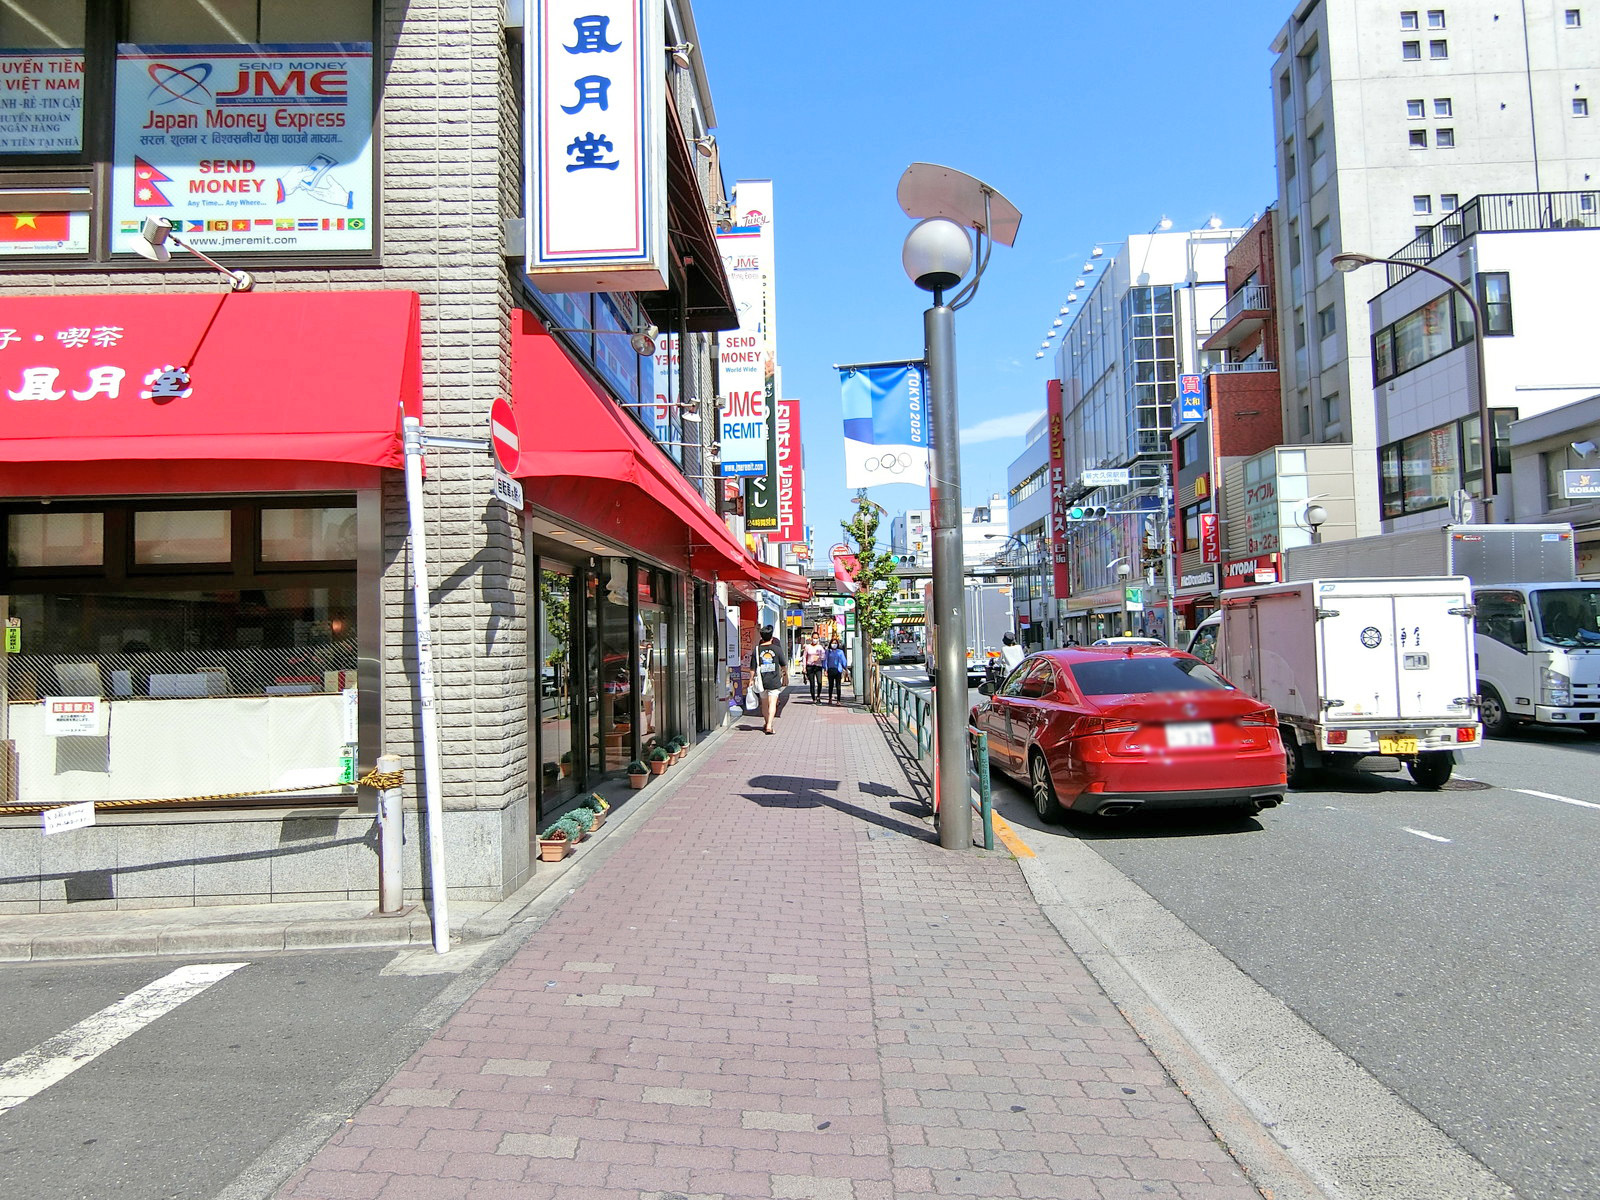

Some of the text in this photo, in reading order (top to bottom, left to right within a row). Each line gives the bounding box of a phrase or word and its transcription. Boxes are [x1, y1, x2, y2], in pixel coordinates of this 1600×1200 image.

[239, 62, 347, 71] SEND MONEY
[5, 76, 80, 94] VIỆT NAM
[216, 71, 348, 96] JME
[143, 109, 346, 133] Japan Money Express
[199, 160, 256, 174] SEND
[189, 179, 266, 193] MONEY
[225, 200, 238, 208] Any
[190, 236, 297, 246] www.jmeremit.com
[734, 258, 759, 269] JME
[726, 337, 756, 348] SEND
[721, 351, 761, 364] MONEY
[1182, 376, 1200, 394] 質
[723, 391, 762, 418] JME
[907, 372, 922, 443] TOKYO 2020
[1184, 397, 1200, 406] 大和
[723, 422, 763, 440] REMIT
[724, 463, 764, 473] www.jmeremit.com
[1085, 471, 1127, 479] 新大久保駅前
[1247, 483, 1275, 505] アイフル
[1206, 526, 1217, 561] アイフル
